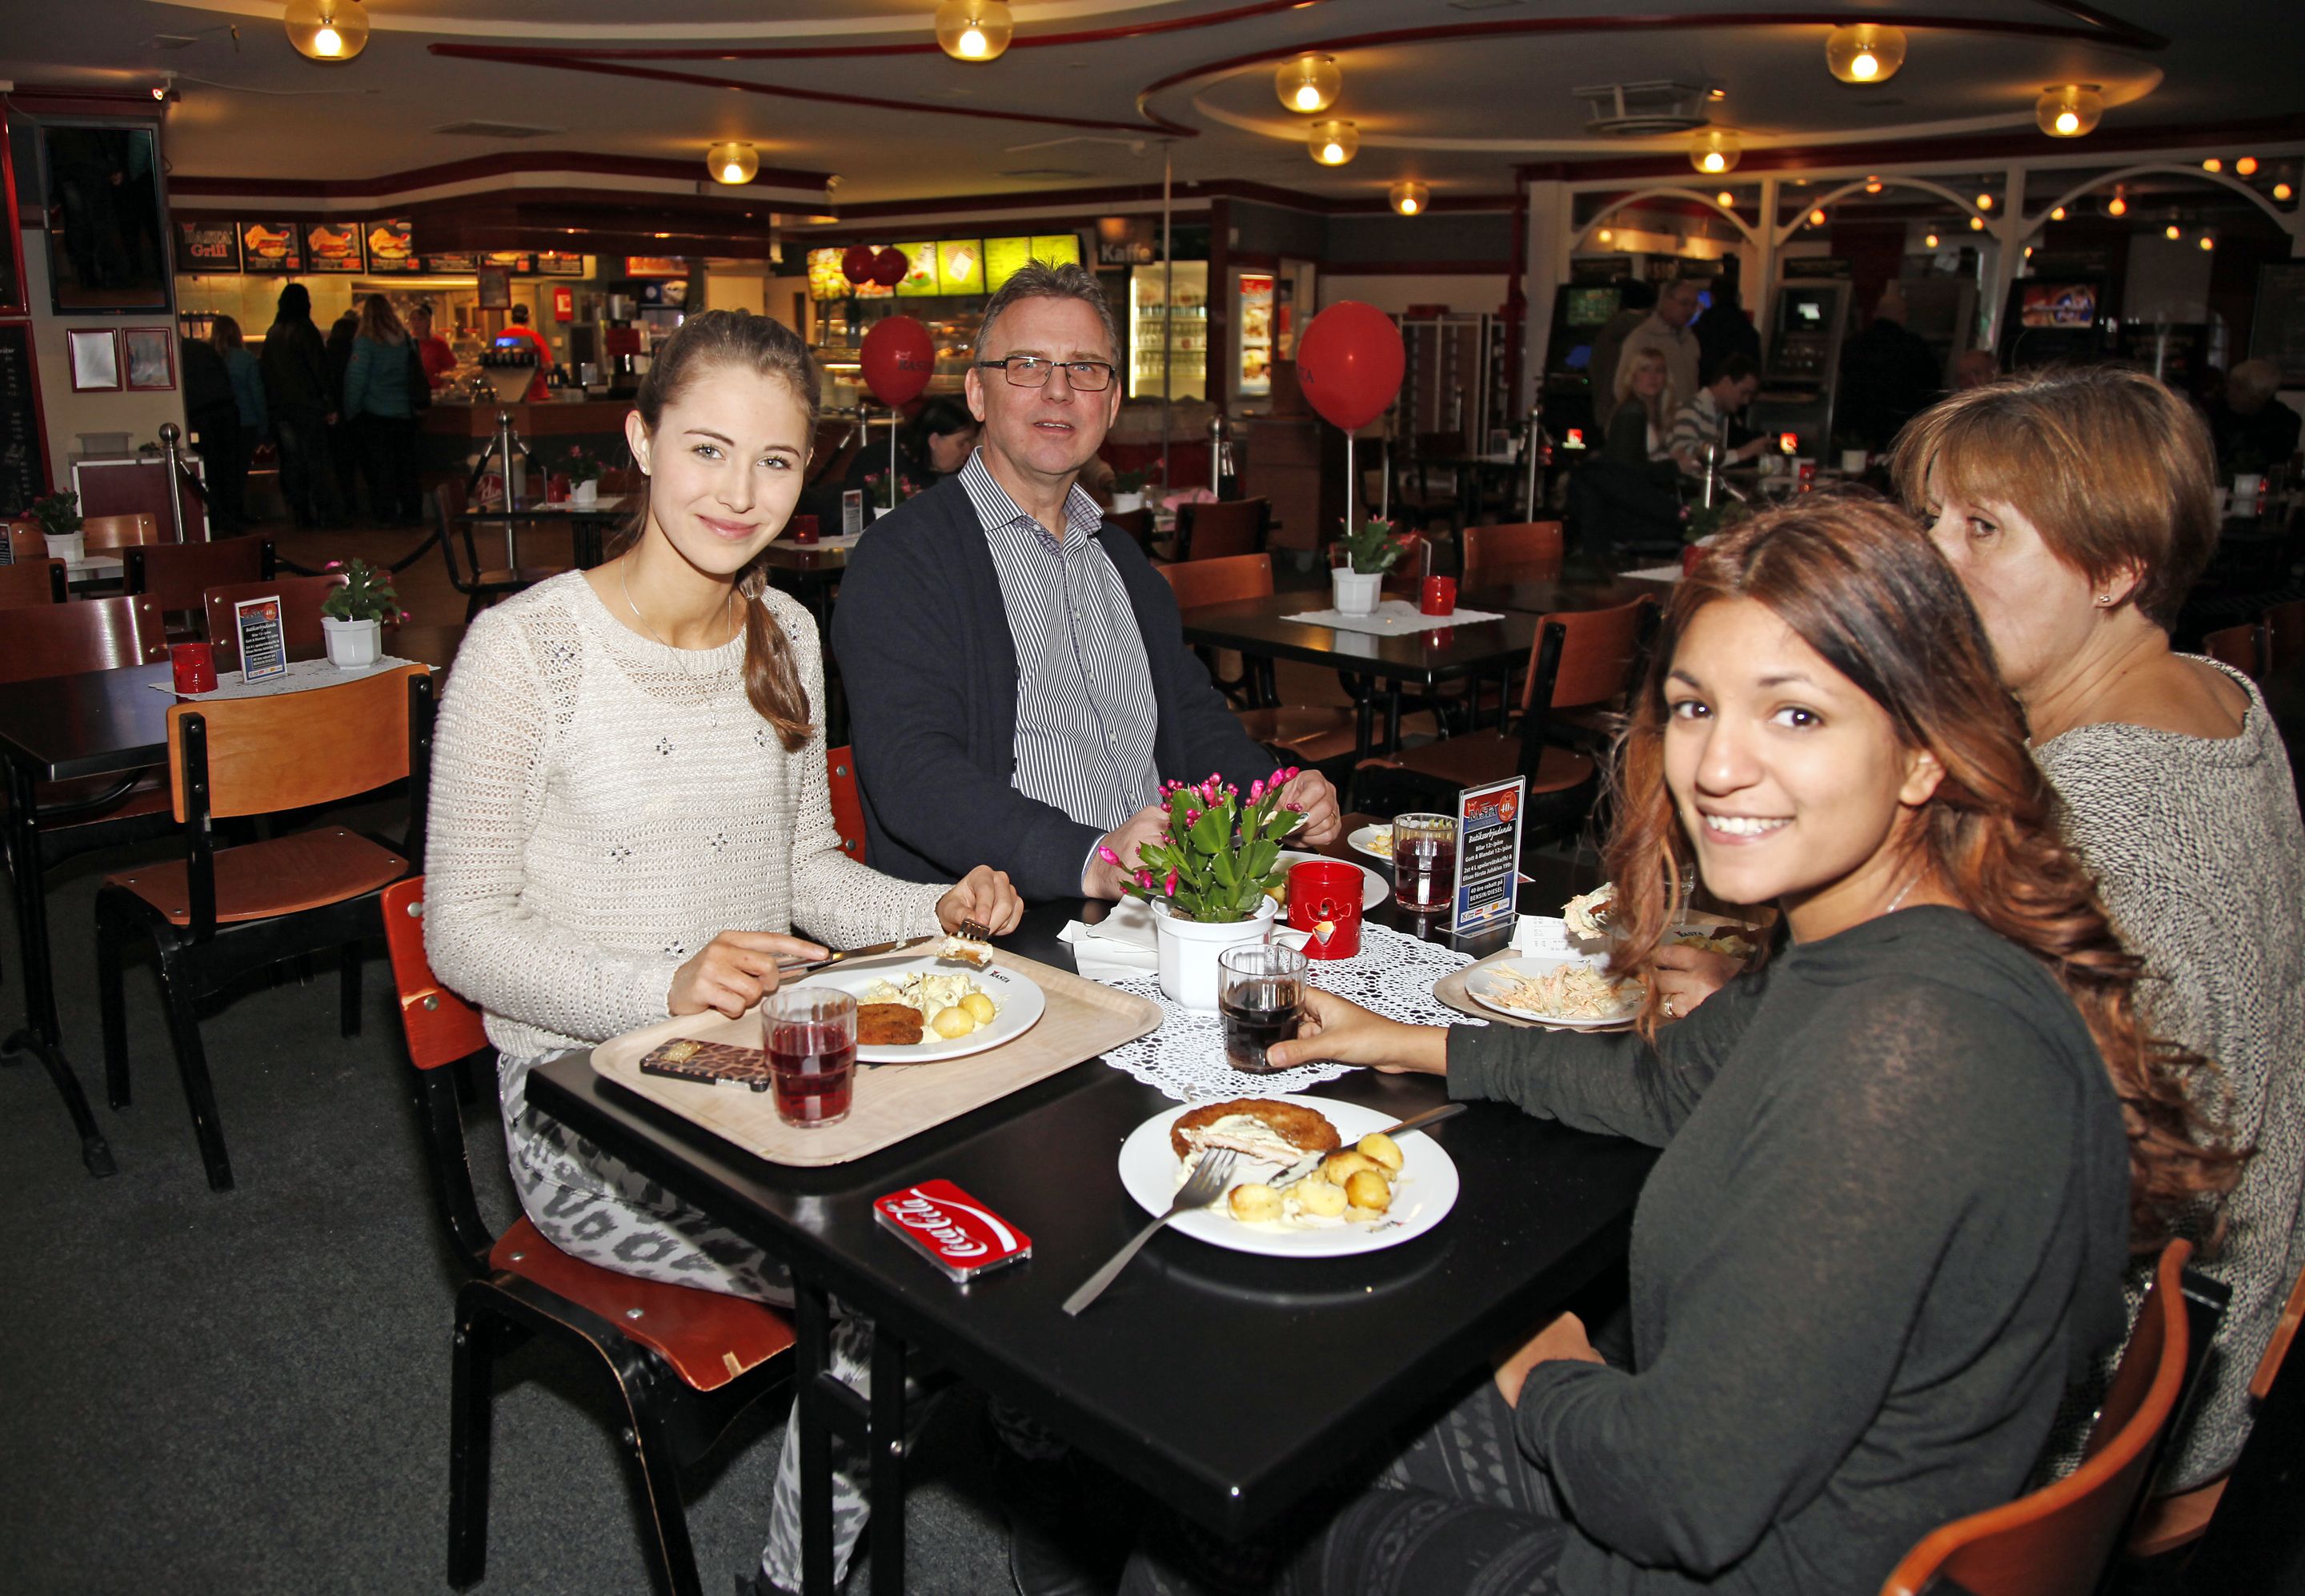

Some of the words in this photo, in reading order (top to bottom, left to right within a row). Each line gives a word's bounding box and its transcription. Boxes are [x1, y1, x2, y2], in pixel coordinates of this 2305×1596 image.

[190, 243, 228, 257] Grill
[1468, 805, 1497, 822] RASTA
[1478, 849, 1494, 859] Blandat
[1497, 879, 1503, 887] på
[989, 972, 1011, 984] RASTA
